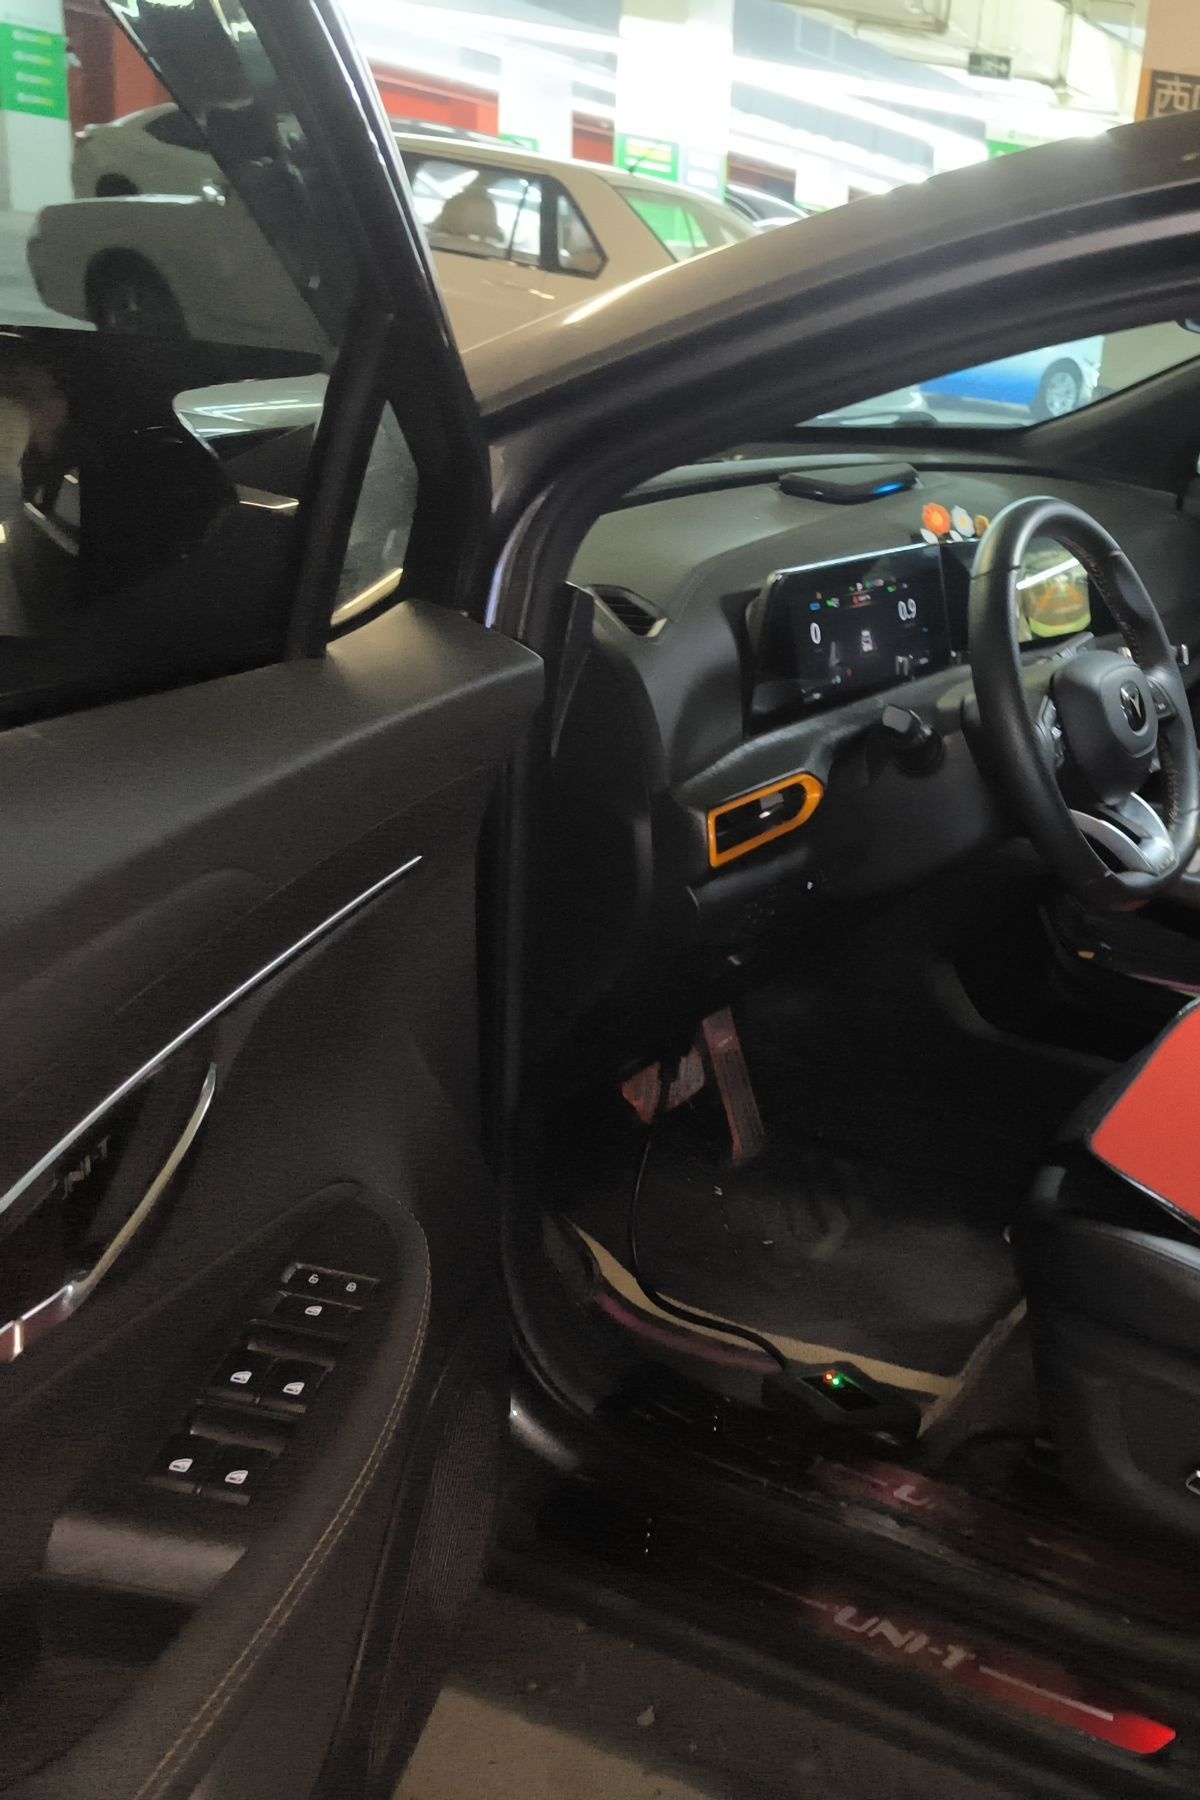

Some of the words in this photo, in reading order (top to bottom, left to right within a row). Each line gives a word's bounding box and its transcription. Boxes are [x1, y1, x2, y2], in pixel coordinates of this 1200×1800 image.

[897, 598, 917, 621] 0.9
[809, 622, 821, 645] 0
[833, 1605, 976, 1670] UNI-T
